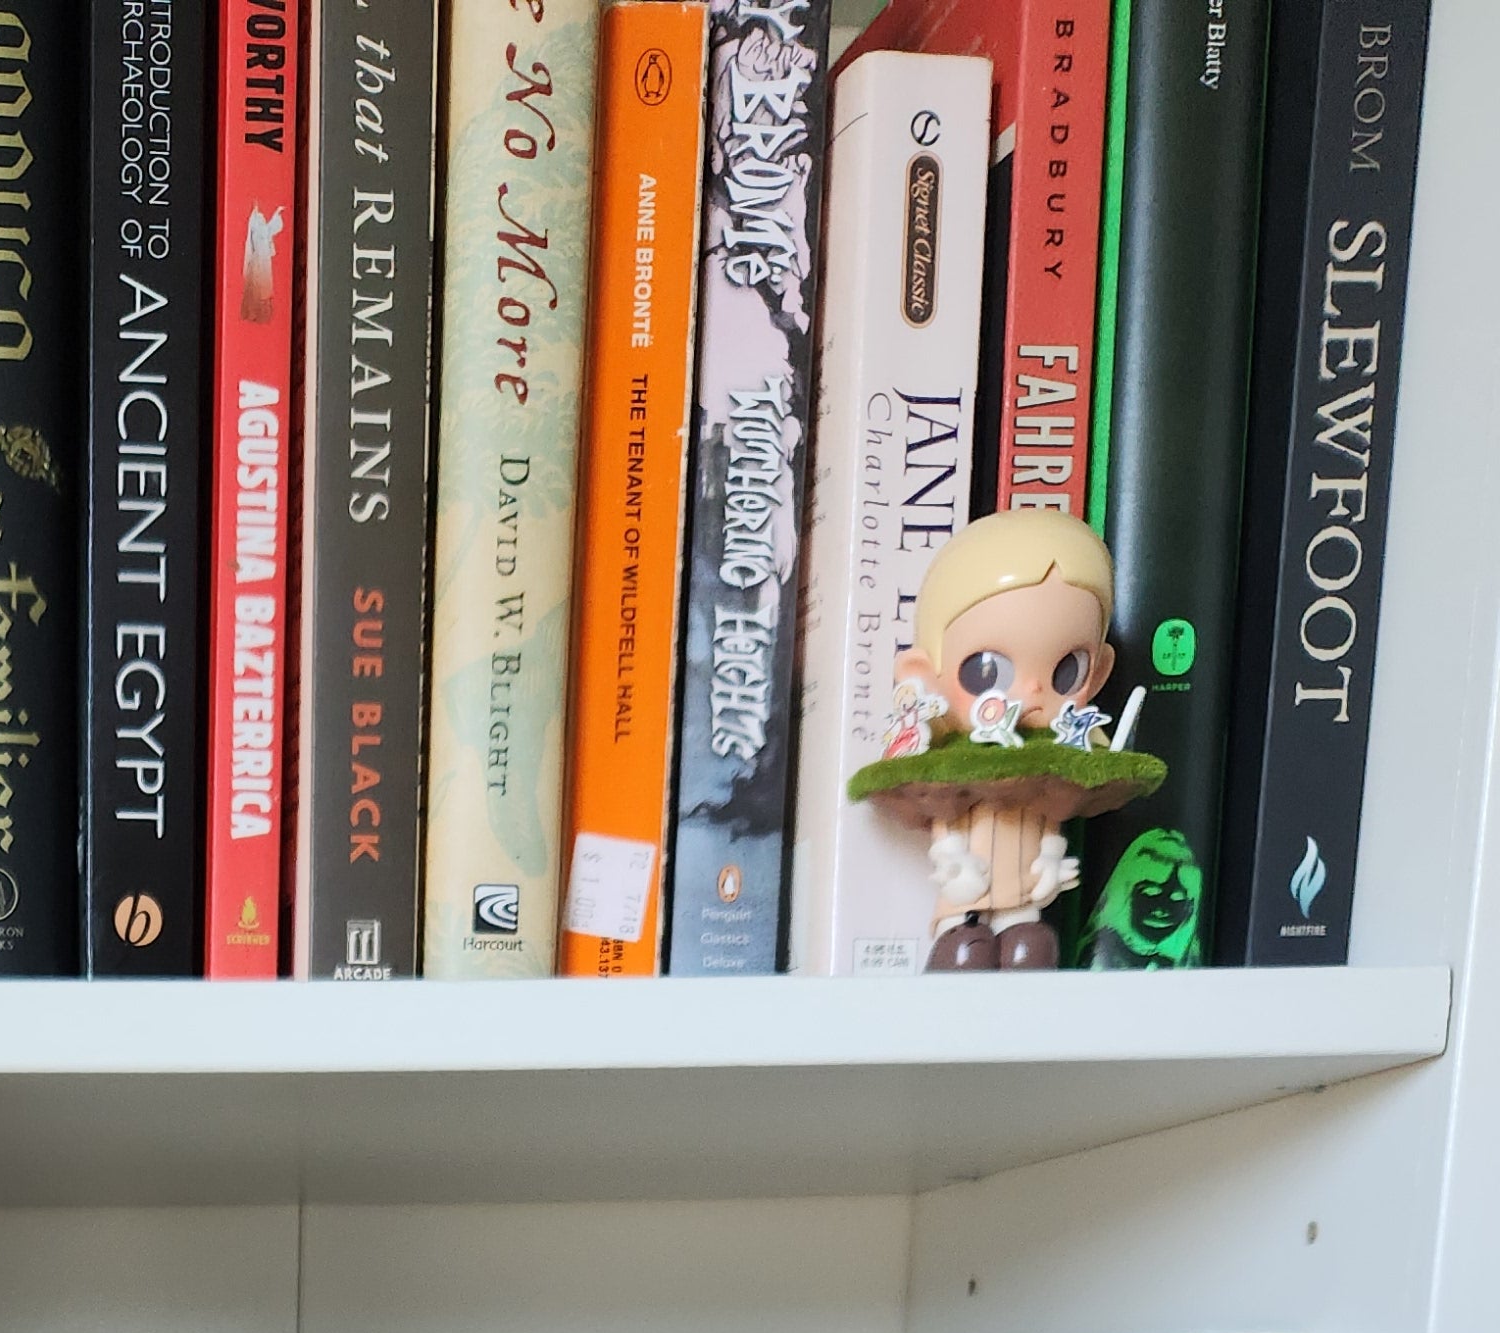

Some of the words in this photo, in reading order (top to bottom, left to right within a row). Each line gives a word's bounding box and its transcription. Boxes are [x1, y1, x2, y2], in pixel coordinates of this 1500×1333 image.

[354, 33, 397, 164] that
[503, 42, 557, 158] No
[1199, 22, 1229, 89] Blatty
[1349, 23, 1393, 174] BROM
[637, 173, 658, 242] ANNE
[910, 167, 935, 235] Signet
[1043, 19, 1076, 281] BRADBURY
[120, 219, 144, 260] OF
[146, 219, 171, 260] TO
[496, 182, 560, 406] More
[911, 237, 933, 317] Classic
[350, 186, 396, 524] REMAINS
[631, 248, 654, 348] BRONTË
[117, 273, 170, 603] ANCIENT
[631, 373, 649, 420] THE
[233, 380, 281, 585] AGUSTINA
[491, 453, 530, 575] DAVID
[625, 425, 646, 524] TENANT
[860, 392, 893, 590] Charlotte
[892, 386, 963, 552] JANE
[1293, 219, 1388, 723] SLEWFOOT
[623, 527, 640, 559] OF
[352, 588, 385, 680] SUE
[617, 564, 639, 678] WILDFELL
[852, 611, 882, 742] Brontë
[113, 621, 169, 838] EGYPT
[230, 593, 278, 841] BAZTERRICA
[486, 654, 523, 798] BLIGHT
[613, 684, 634, 743] HALL
[350, 701, 383, 863] BLACK
[333, 966, 392, 981] ARCADE
[462, 937, 525, 952] Harcourt
[700, 908, 752, 923] Penguin
